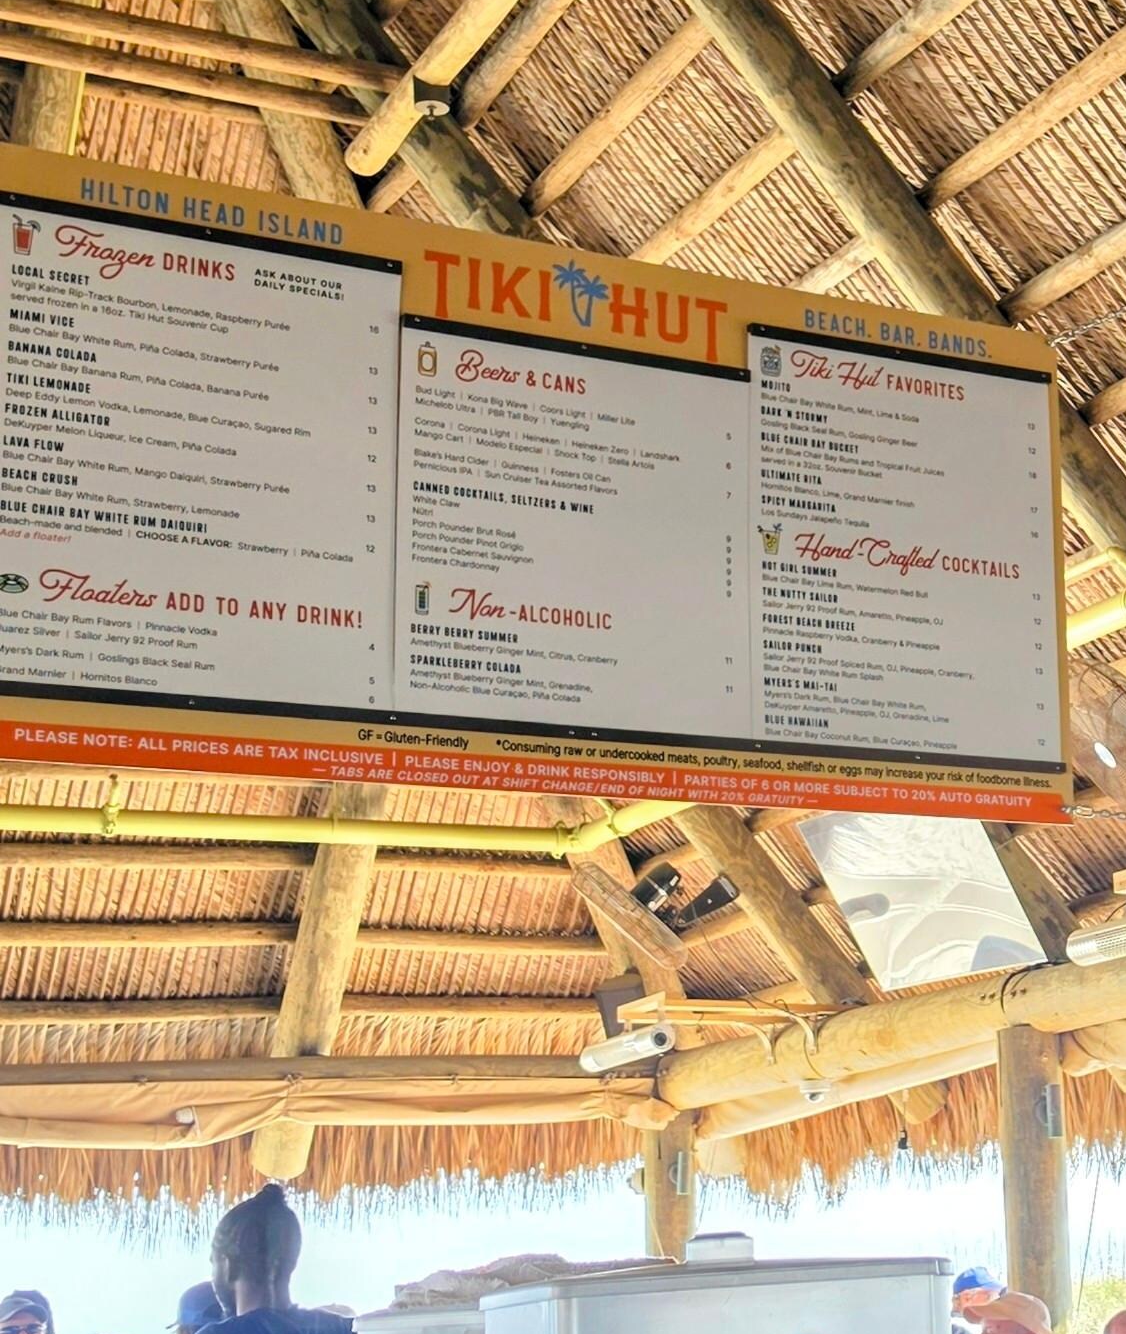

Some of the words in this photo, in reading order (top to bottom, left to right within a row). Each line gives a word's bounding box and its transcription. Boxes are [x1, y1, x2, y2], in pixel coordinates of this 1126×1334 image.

[80, 177, 170, 215] HILTON
[183, 196, 245, 228] HEAD
[258, 210, 344, 245] ISLAND
[54, 224, 155, 279] Frozen
[162, 252, 235, 281] DRINKS
[11, 263, 45, 279] LOCAL
[48, 269, 90, 285] SECRET
[254, 268, 276, 279] ASK
[279, 272, 317, 285] ABOUT
[320, 279, 342, 289] OUR
[254, 278, 286, 290] DAILY
[288, 284, 345, 300] SPECIALS!
[9, 308, 46, 323] MIAMI
[49, 314, 75, 327] VICE
[424, 249, 553, 321] TIKI
[609, 283, 728, 364] HUT
[804, 309, 872, 338] BEACH.
[880, 322, 921, 347] BAR.
[928, 330, 993, 359] BANDS.
[7, 340, 52, 355] BANANA
[55, 346, 97, 362] COLADA
[6, 372, 29, 385] TIKI
[33, 375, 91, 394] LEMONADE
[455, 349, 521, 383] Beers
[525, 370, 537, 386] &
[542, 372, 586, 394] CANS
[790, 352, 832, 379] Tiki
[837, 361, 884, 389] Hut
[887, 374, 964, 401] FAVORITES
[761, 379, 791, 392] MOJITO
[4, 402, 48, 417] FROZEN
[51, 408, 111, 426] ALLIGATOR
[3, 434, 30, 447] LAVA
[33, 438, 64, 451] FLOW
[0, 467, 38, 481] BEACH
[41, 471, 78, 485] CRUSH
[413, 480, 450, 494] CANNED
[453, 486, 508, 503] COCKTAILS,
[511, 494, 556, 509] SELTZERS
[559, 500, 567, 510] &
[570, 502, 594, 514] WINE
[794, 532, 940, 576] Hand-Crafted
[942, 555, 1020, 579] COCKTAILS
[762, 560, 777, 570] HOT
[780, 562, 799, 573] GIRL
[801, 565, 837, 577] SUMMER
[39, 568, 158, 607] Floaters
[165, 591, 205, 612] ADD
[215, 596, 239, 615] TO
[249, 600, 287, 620] ANY
[297, 604, 362, 627] DRINK!
[762, 586, 777, 596] THE
[780, 588, 807, 599] NUTTY
[809, 591, 838, 603] SAILOR
[410, 622, 441, 635] BERRY
[444, 626, 474, 639] BERRY
[477, 630, 518, 643] SUMMER
[763, 639, 792, 650] SAILOR
[795, 642, 822, 653] PUNCH
[410, 654, 483, 670] SPARKLEBERRY
[486, 661, 521, 673] COLADA
[14, 728, 77, 744] PLEASE
[83, 733, 132, 747] NOTE:
[137, 736, 166, 750] ALL
[172, 739, 228, 754] PRICES
[233, 743, 263, 756] ARE
[268, 746, 298, 759] TAX
[303, 748, 383, 764] INCLUSIVE
[357, 728, 374, 740] GF
[383, 730, 470, 750] Gluten-Friendly
[404, 755, 458, 770] PLEASE
[463, 759, 510, 773] ENJOY
[514, 762, 523, 774] &
[527, 763, 568, 776] DRINK
[573, 766, 664, 783] RESPONSIBLY
[563, 746, 584, 755] raw
[585, 747, 597, 756] or
[599, 747, 665, 762] undercooked
[667, 753, 701, 766] meats,
[703, 755, 741, 769] poultry,
[742, 757, 784, 771] seafood,
[786, 760, 825, 772] shellfish
[827, 764, 838, 773] or
[839, 765, 863, 777] eggs
[864, 767, 884, 778] may
[885, 766, 924, 779] increase
[925, 771, 946, 782] your
[947, 770, 964, 781] risk
[964, 771, 975, 782] of
[976, 772, 1022, 786] foodborne
[330, 765, 364, 777] TABS
[367, 768, 394, 779] ARE
[396, 770, 449, 783] CLOSED
[452, 773, 481, 784] OUT
[482, 776, 500, 785] AT
[502, 776, 539, 787] SHIFT
[541, 779, 625, 794] CHANGE/END
[628, 785, 644, 795] OF
[647, 786, 685, 797] NIGHT
[687, 789, 719, 799] WITH
[721, 791, 744, 801] 20%
[747, 793, 804, 804] GRATUITY
[684, 774, 737, 788] PARTIES
[740, 778, 757, 789] OF
[761, 779, 769, 790] 6
[772, 780, 790, 791] OR
[793, 781, 829, 793] MORE
[833, 784, 888, 797] SUBJECT
[891, 787, 908, 799] TO
[911, 789, 935, 800] 20%
[939, 791, 972, 803] AUTO
[974, 793, 1031, 806] GRATUITY
